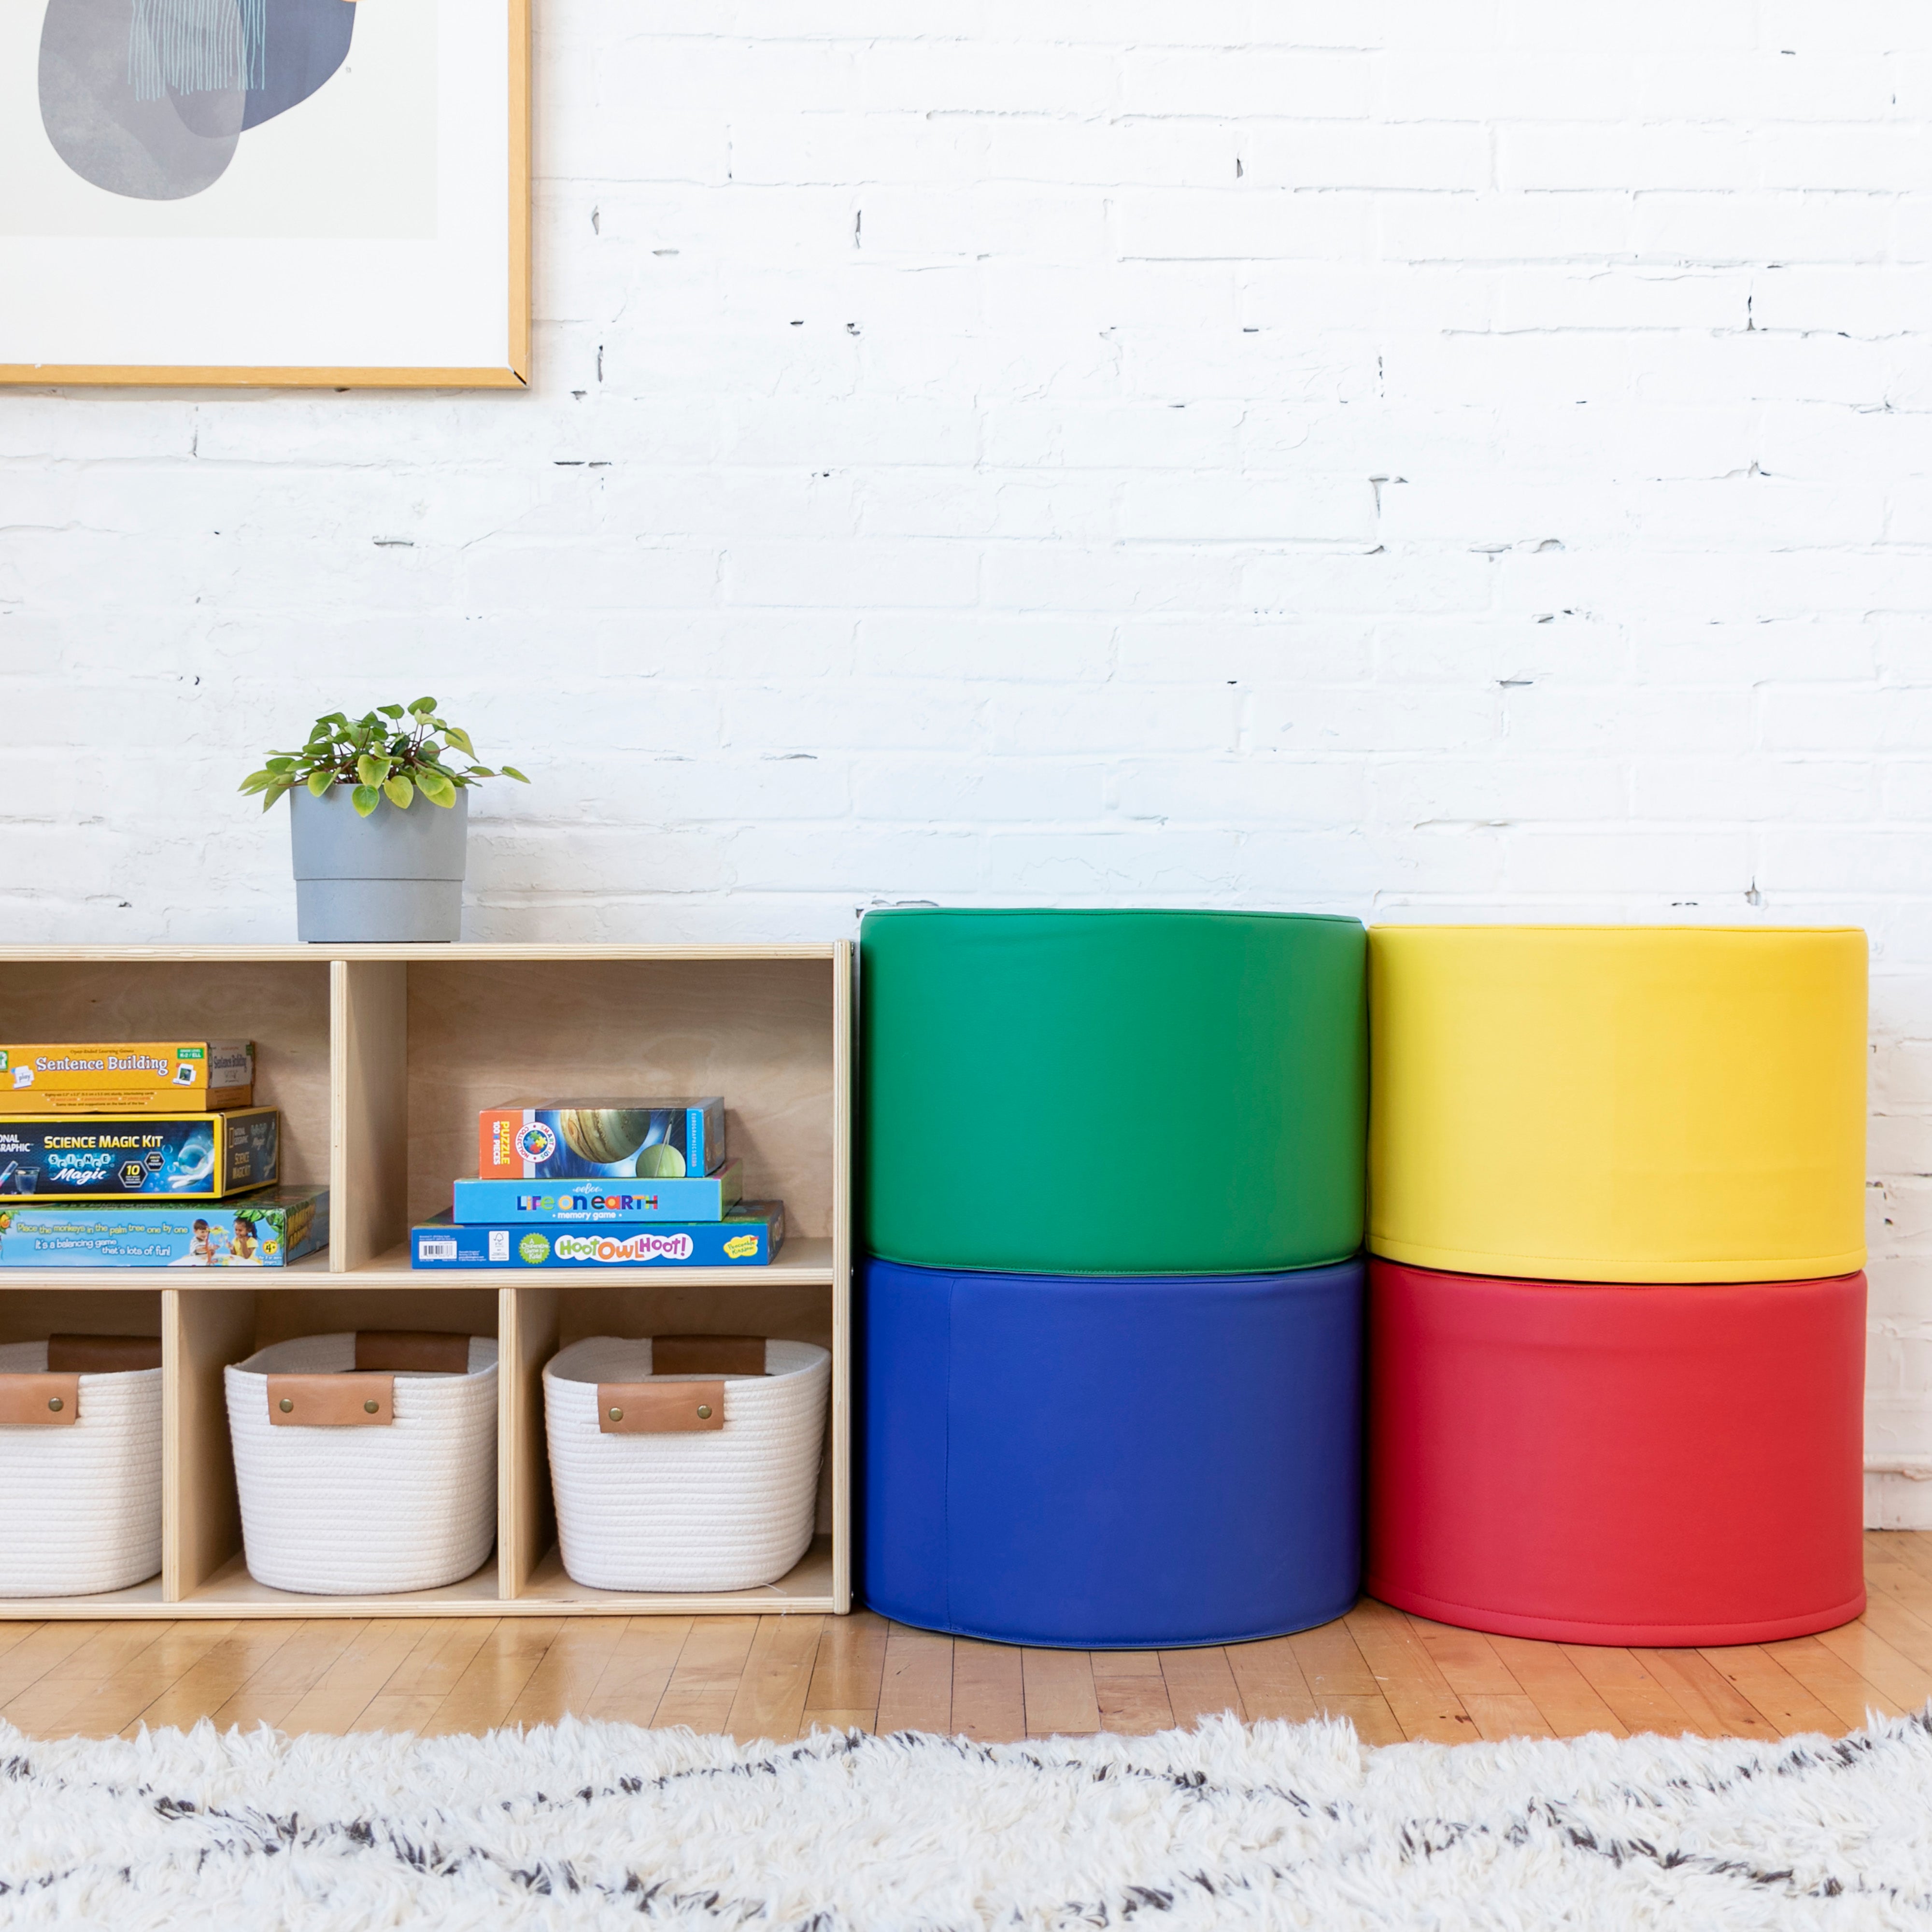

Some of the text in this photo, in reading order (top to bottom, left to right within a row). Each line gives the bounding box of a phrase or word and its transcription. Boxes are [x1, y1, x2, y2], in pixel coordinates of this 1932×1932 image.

[35, 1054, 169, 1076] Sentence Building
[19, 1072, 31, 1083] play
[44, 1135, 164, 1149] SCIENCE MAGIC KIT
[501, 1121, 510, 1165] PUZZLE
[517, 1126, 529, 1158] COLLECTION
[540, 1125, 554, 1159] SMART KIDS
[51, 1155, 109, 1168] SCIENCE
[50, 1168, 107, 1185] Magic
[126, 1165, 140, 1176] 10
[558, 1195, 587, 1210] on
[557, 1212, 616, 1220] memory game
[17, 1223, 38, 1232] Place
[39, 1225, 52, 1234] the
[54, 1223, 85, 1235] monkeys
[87, 1225, 94, 1234] in
[95, 1223, 108, 1232] the
[109, 1225, 127, 1236] palm
[163, 1222, 172, 1234] by
[35, 1239, 48, 1250] It's
[56, 1238, 93, 1249] balancing
[95, 1239, 117, 1248] game
[102, 1245, 170, 1256] that's lots of fun!
[266, 1244, 276, 1252] 4+
